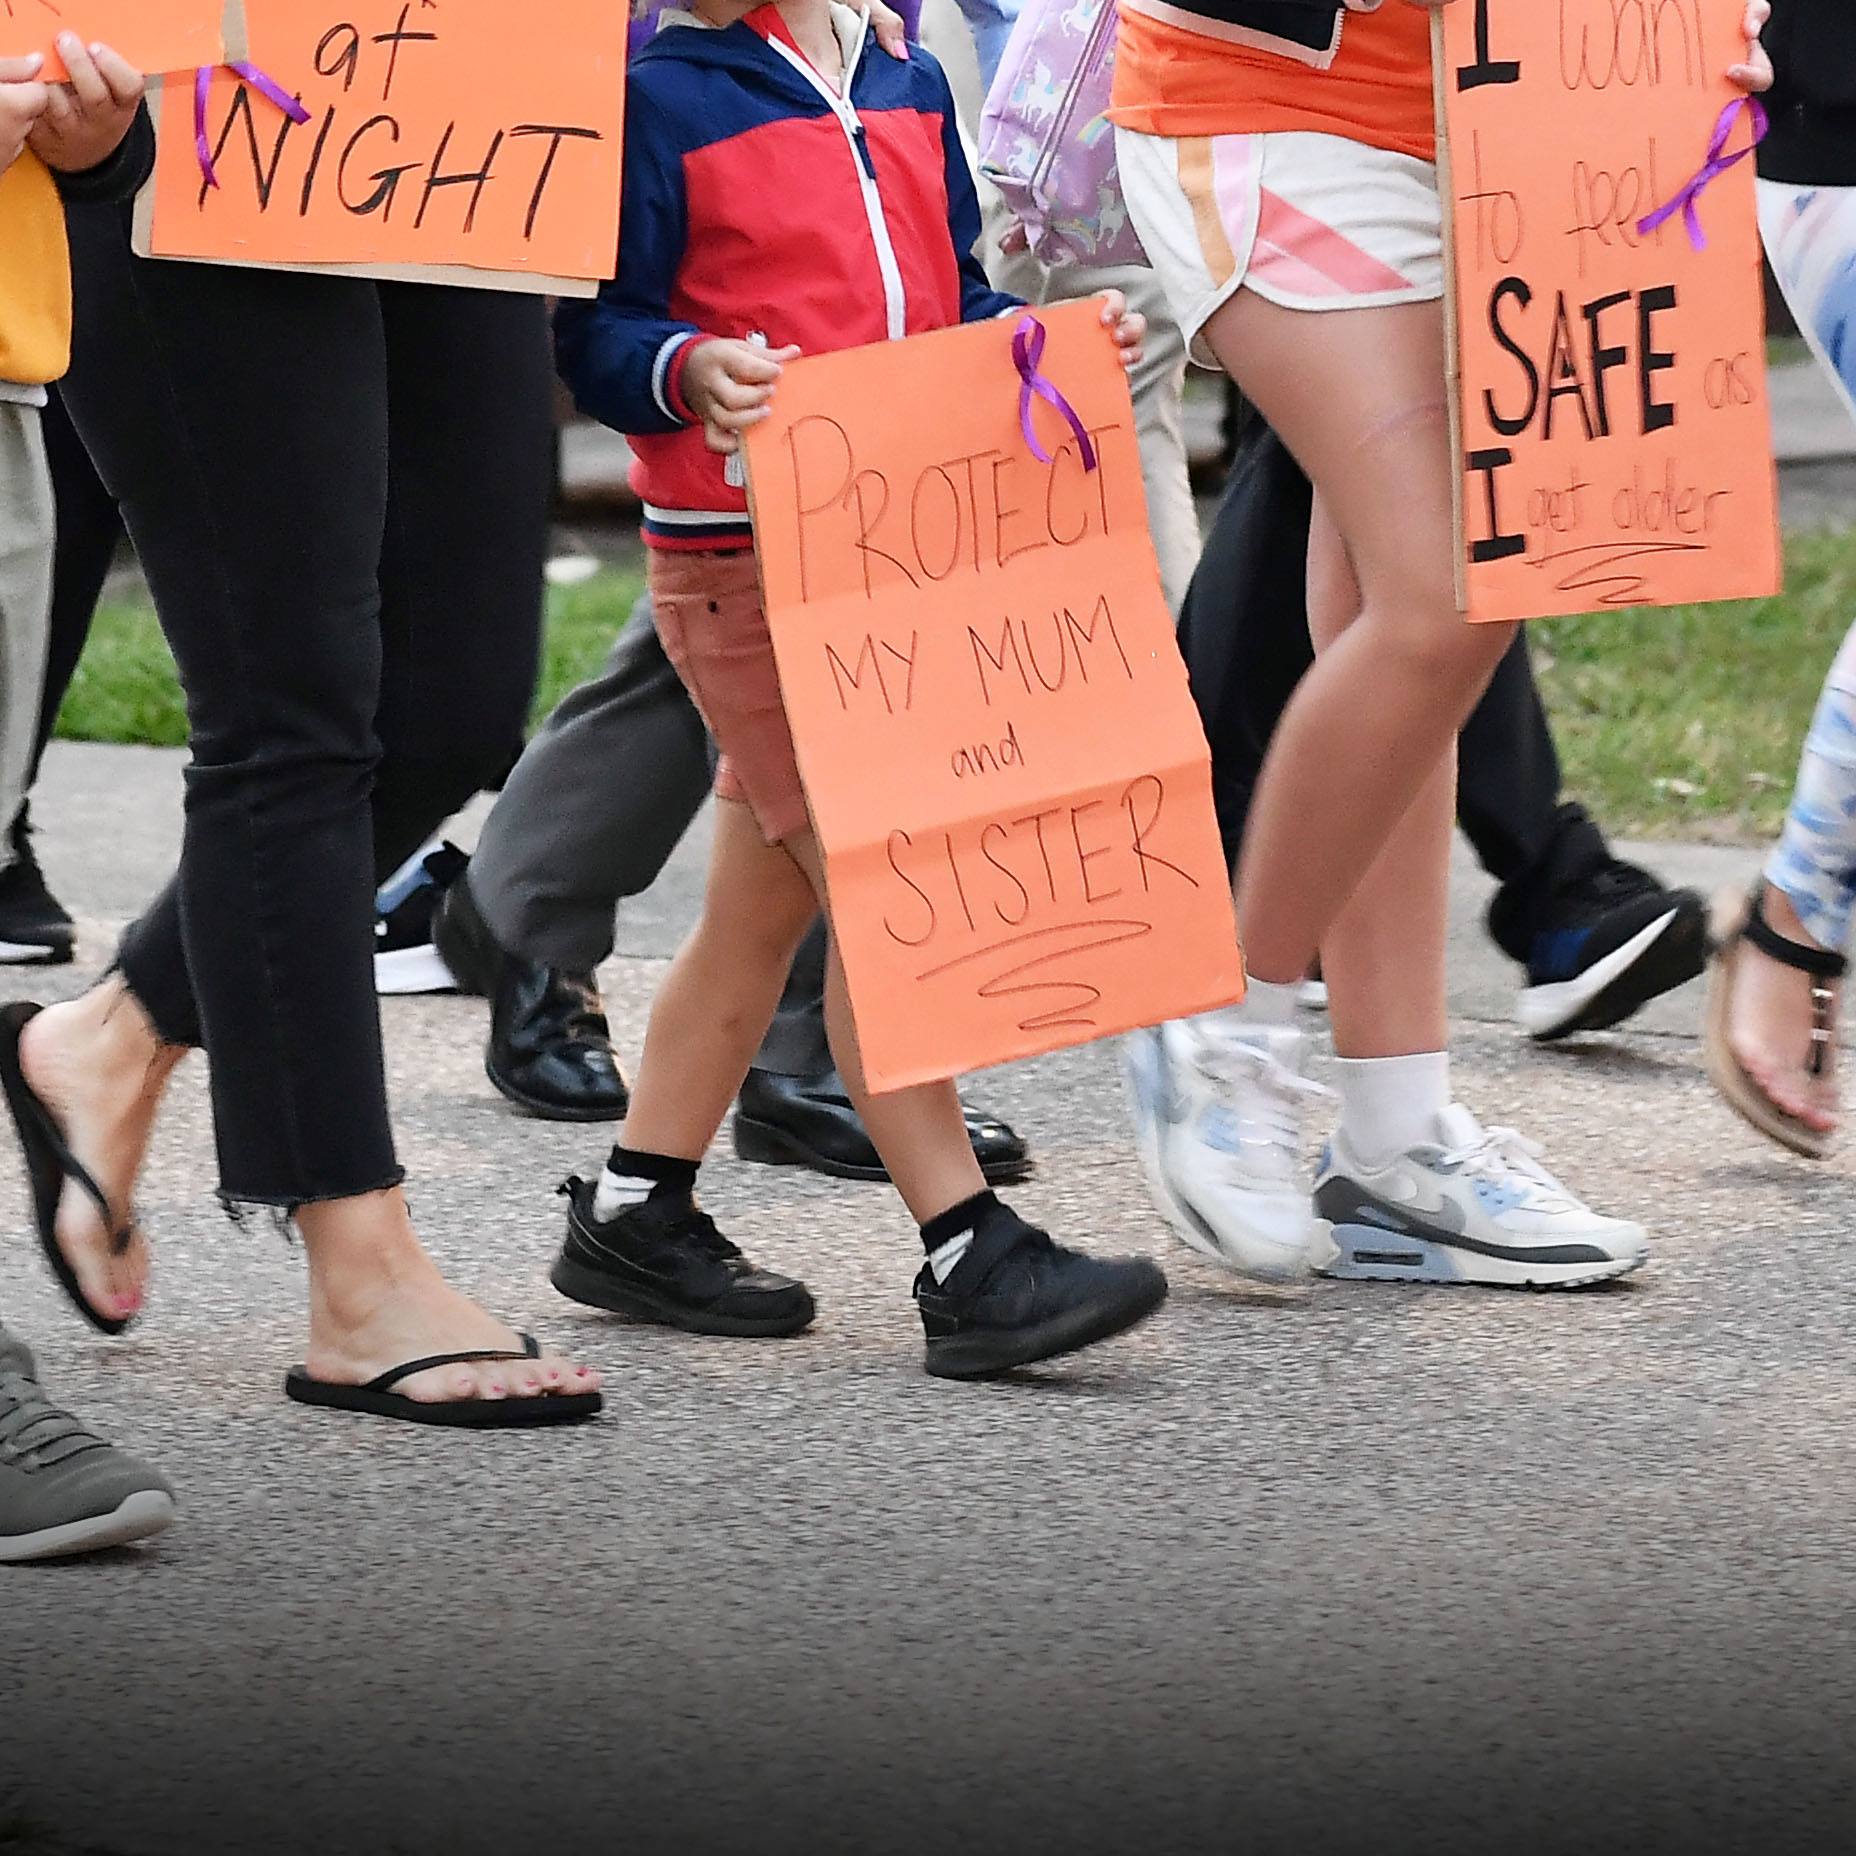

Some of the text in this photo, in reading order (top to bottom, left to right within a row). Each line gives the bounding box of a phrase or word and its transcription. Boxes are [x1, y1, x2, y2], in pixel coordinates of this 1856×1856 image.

[314, 2, 438, 101] at
[197, 82, 604, 241] NIGHT
[1459, 128, 1663, 279] to feel
[1482, 275, 1753, 441] SAFE as
[782, 414, 1122, 603] PROTECT
[1464, 446, 1734, 568] I get older
[824, 593, 1132, 715] MY MUM
[950, 721, 1025, 781] and
[882, 774, 1200, 947] SISTER
